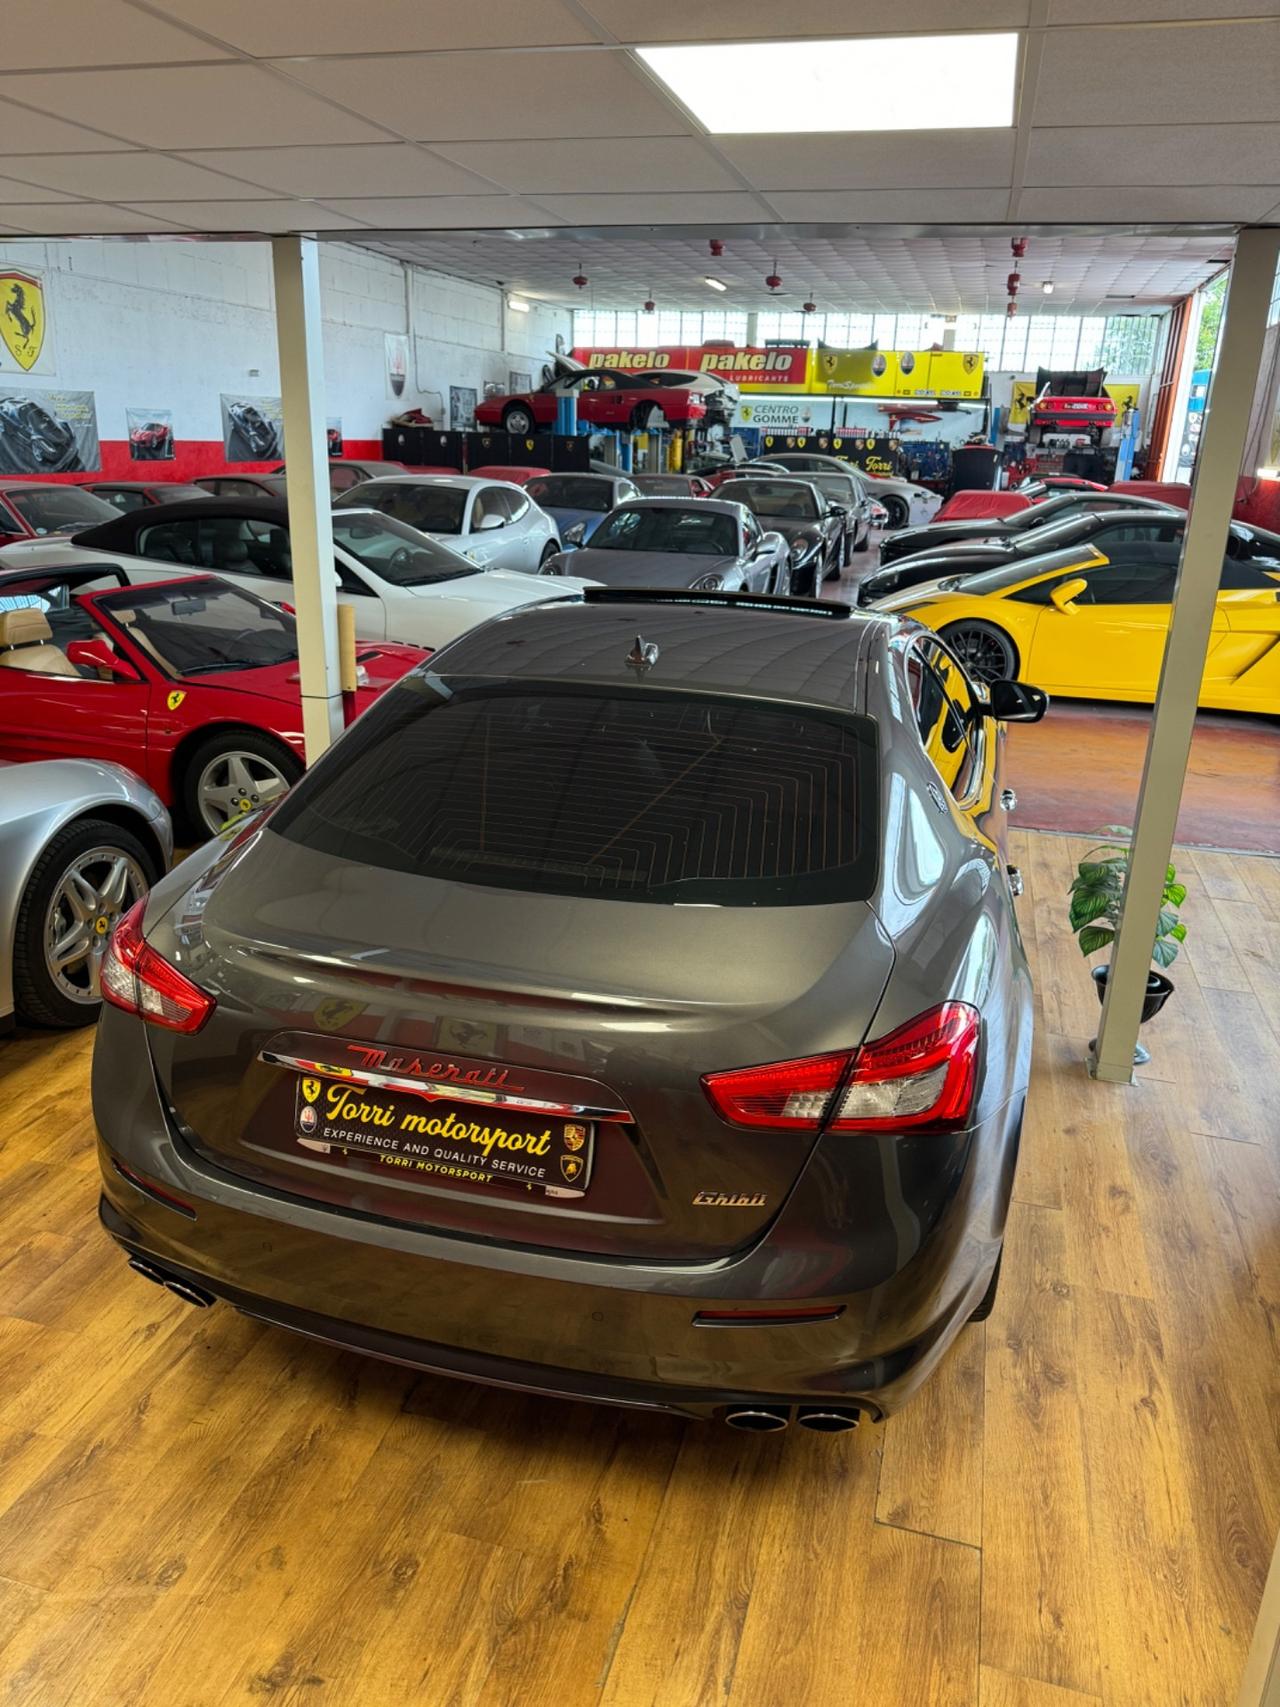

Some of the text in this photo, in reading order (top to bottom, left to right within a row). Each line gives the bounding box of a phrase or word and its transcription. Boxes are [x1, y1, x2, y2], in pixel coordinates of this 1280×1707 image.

[588, 351, 670, 369] pakelo
[700, 351, 792, 371] pakelo
[729, 374, 789, 382] LUBRICANTS
[753, 414, 799, 423] GOMME
[754, 405, 799, 414] CENTRO
[866, 456, 893, 471] Torri
[347, 1044, 525, 1093] Maserati
[326, 1083, 551, 1157] Torri motorsport
[323, 1127, 547, 1178] EXPERIENCE AND QUALITY SERVICE
[379, 1154, 494, 1183] TORRI MOTORSPORT
[692, 1191, 768, 1206] Ghibli
